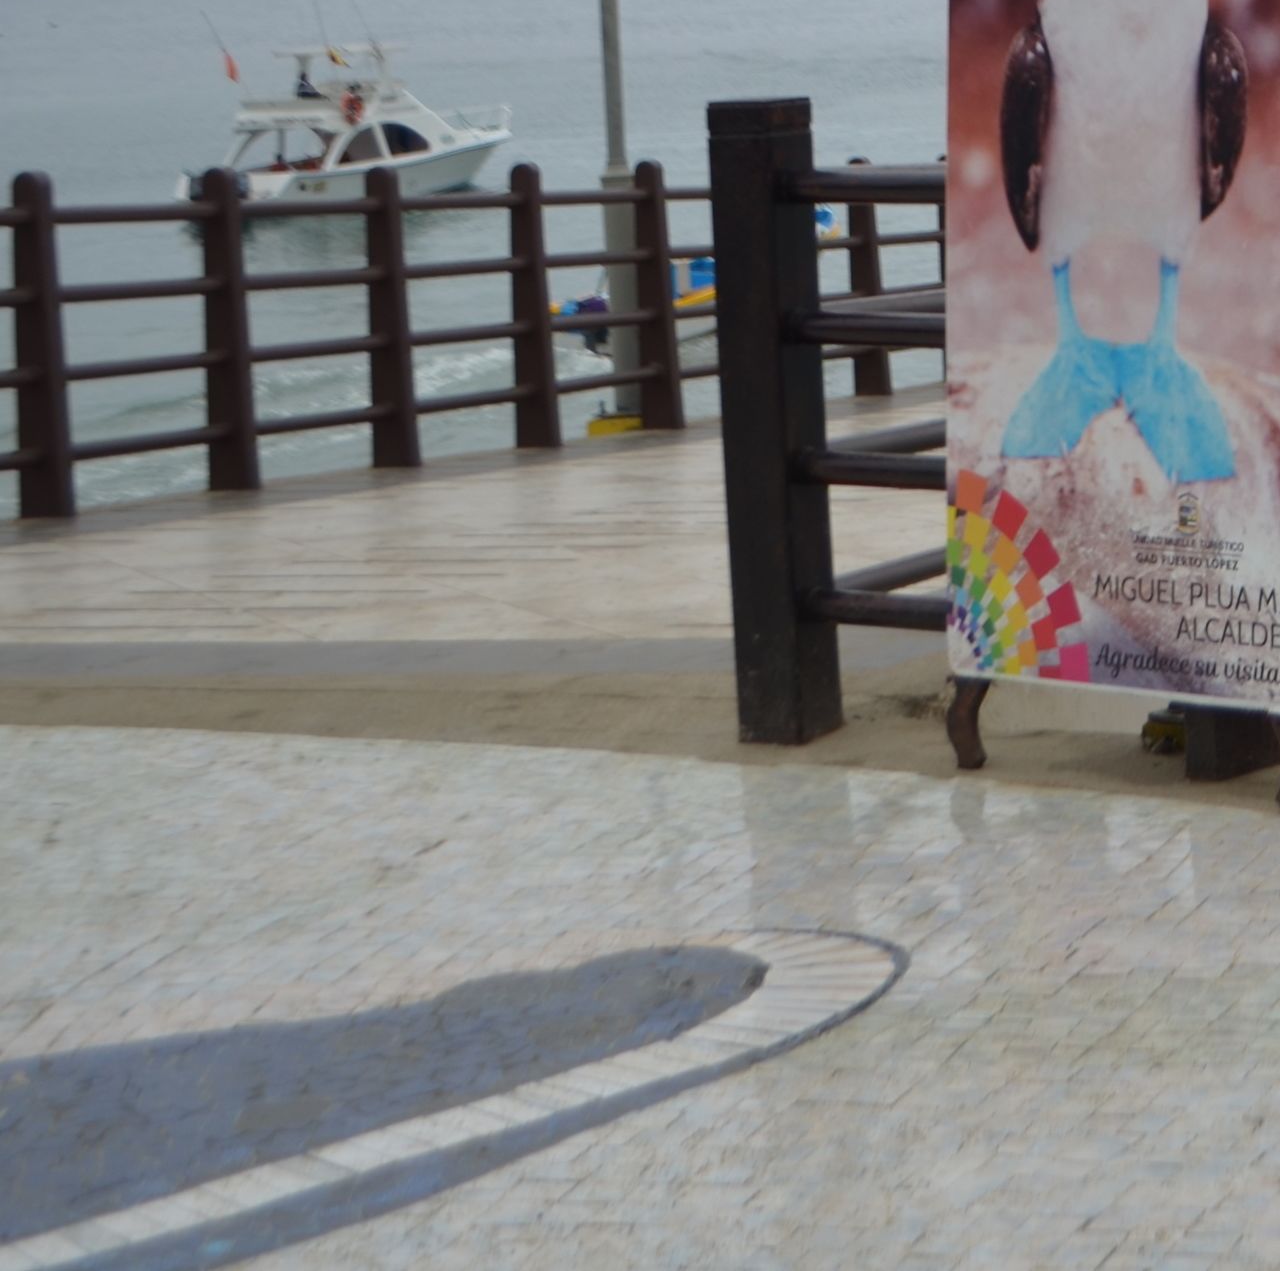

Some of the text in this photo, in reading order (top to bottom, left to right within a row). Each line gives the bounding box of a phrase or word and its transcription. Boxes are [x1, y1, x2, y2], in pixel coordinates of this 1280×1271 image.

[1161, 554, 1202, 569] PUERTO
[1093, 575, 1183, 605] MIGUEL
[1189, 582, 1250, 611] PLUA
[1095, 643, 1191, 678] Agradece
[1193, 659, 1219, 678] su
